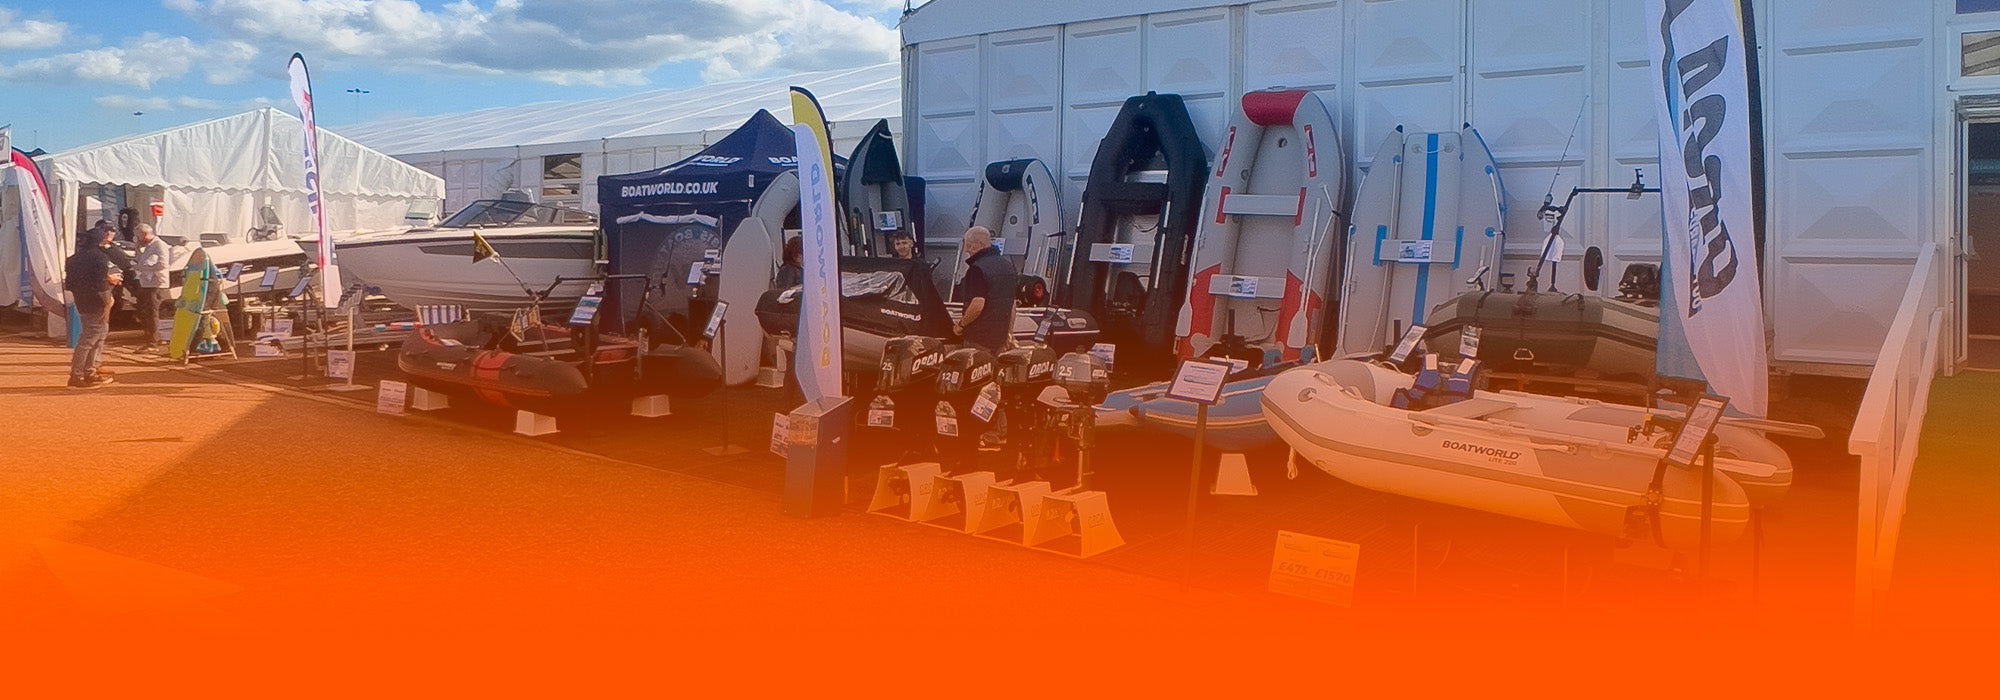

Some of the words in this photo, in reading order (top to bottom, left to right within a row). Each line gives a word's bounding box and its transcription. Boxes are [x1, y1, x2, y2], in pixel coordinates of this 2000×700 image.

[621, 181, 719, 198] BOATWORLD.CO.UK
[880, 307, 922, 323] BOATWORLD
[882, 361, 893, 371] 25
[912, 351, 939, 374] ORCA
[1029, 361, 1050, 378] ORCA
[942, 371, 952, 381] 12
[971, 362, 993, 382] ORCA
[1442, 440, 1520, 460] BOATWORLD
[1278, 560, 1310, 575] £475
[1314, 568, 1351, 584] £1570
